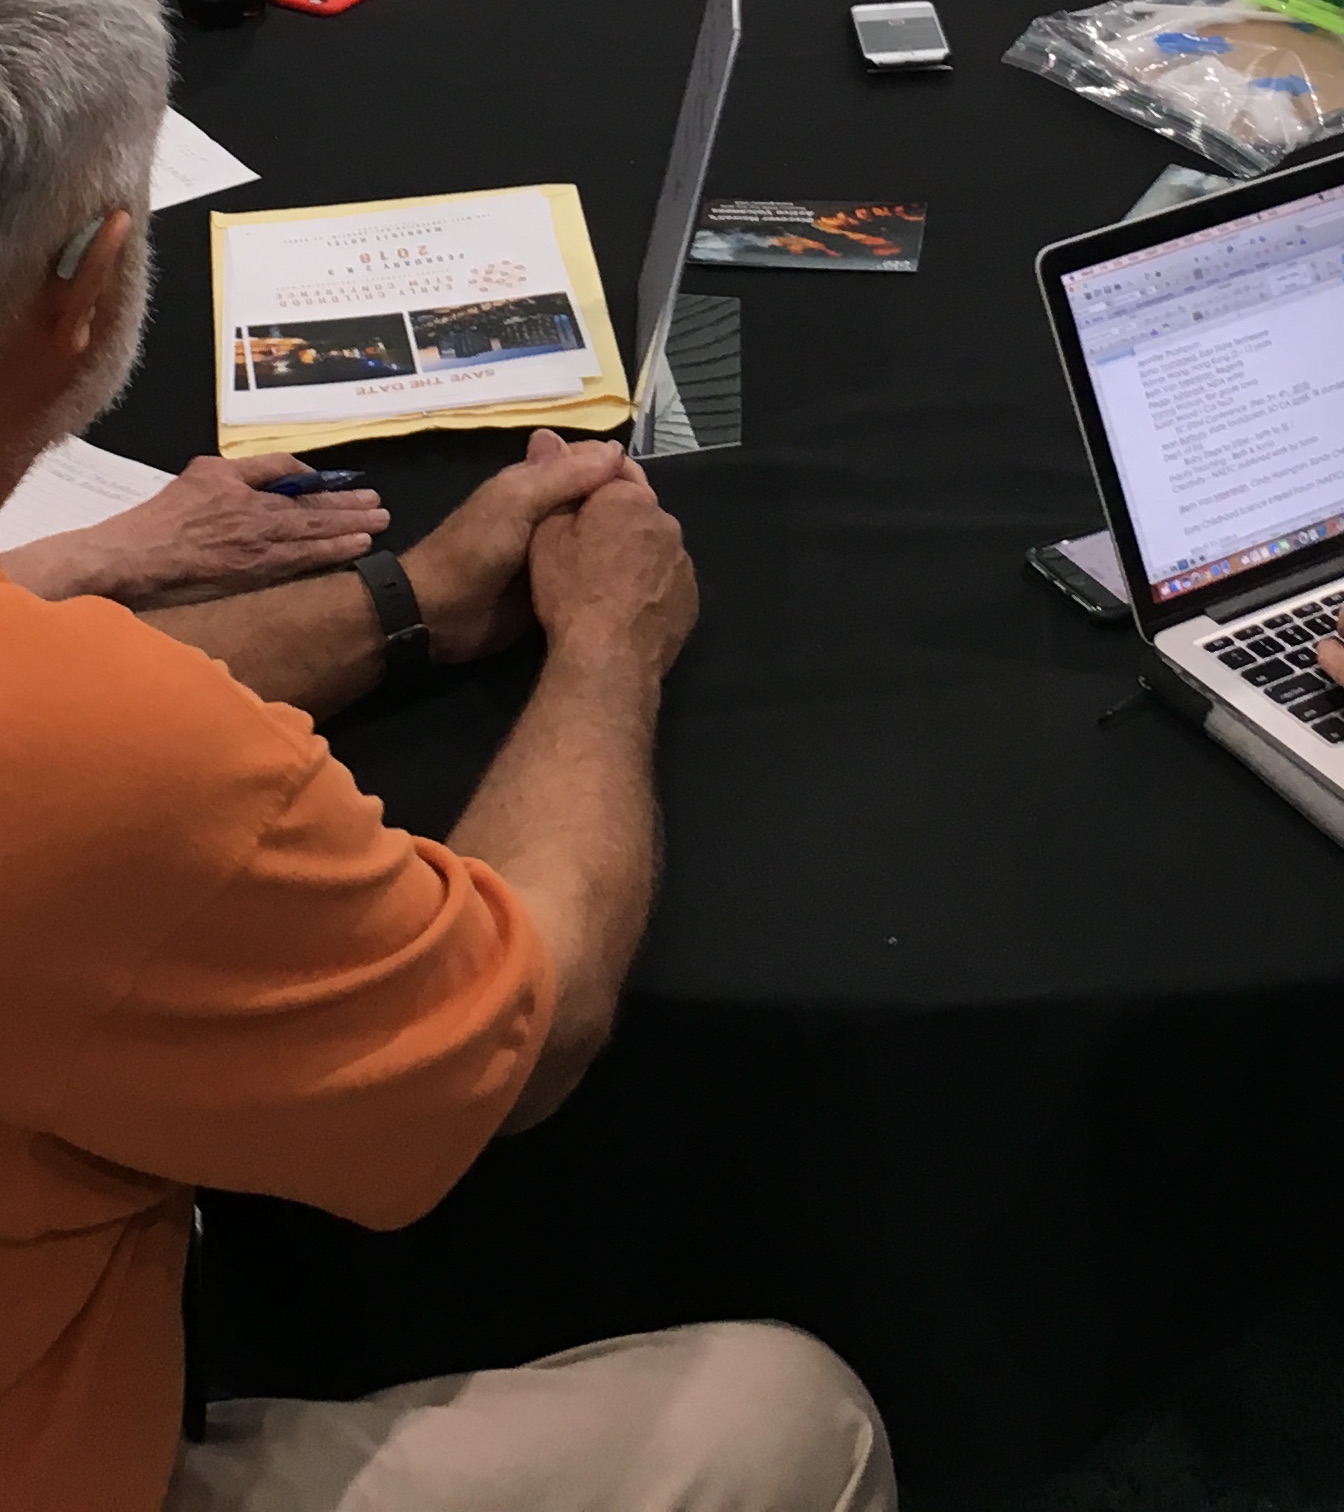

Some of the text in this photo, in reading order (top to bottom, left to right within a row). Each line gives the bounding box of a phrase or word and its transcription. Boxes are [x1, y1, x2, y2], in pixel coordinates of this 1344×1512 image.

[358, 244, 430, 264] 2018
[383, 252, 465, 270] FEBRUARY
[275, 274, 454, 300] STEM CONFERENCE
[279, 291, 387, 308] CHILDHOOD
[355, 368, 496, 396] SAVE THE DATE
